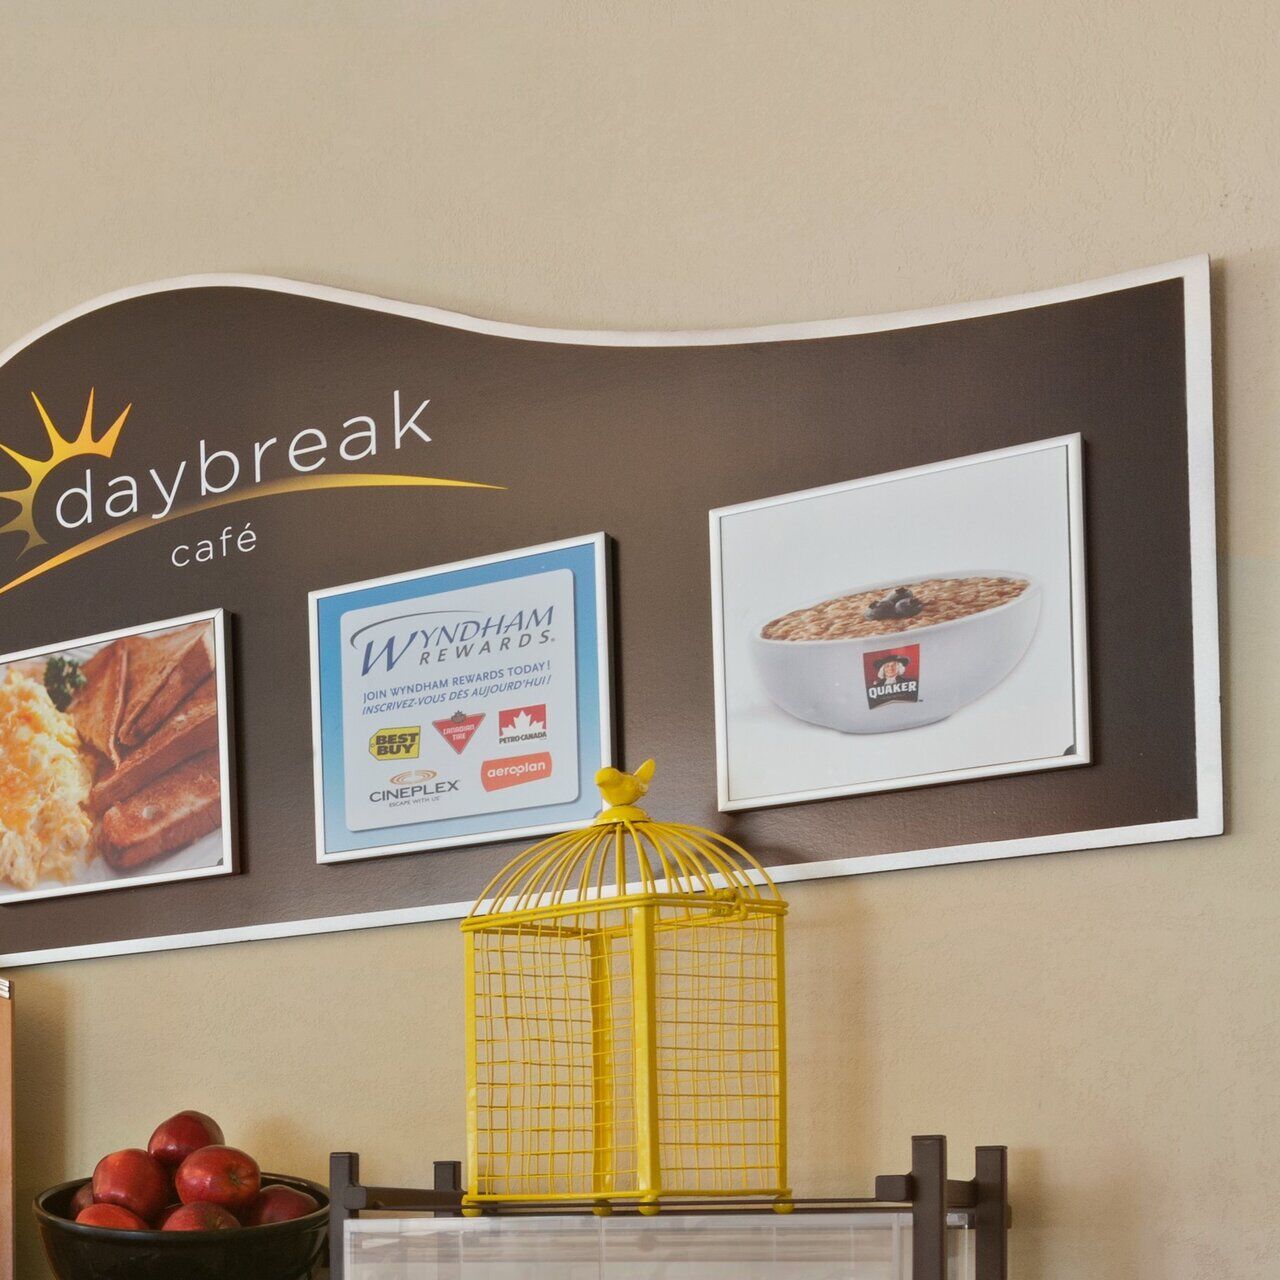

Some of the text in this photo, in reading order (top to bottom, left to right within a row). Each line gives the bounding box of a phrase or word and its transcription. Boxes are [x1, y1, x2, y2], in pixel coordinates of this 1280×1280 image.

[55, 389, 432, 529] daybreak
[171, 523, 257, 567] café
[361, 605, 555, 677] WYNDHAM
[363, 690, 388, 704] JOIN
[390, 678, 449, 697] WYNDHAM
[452, 668, 505, 687] REWARDS
[869, 681, 917, 699] QUAKER
[362, 692, 447, 716] INSCRIVEZ-VOUS
[376, 732, 420, 746] BEST
[377, 743, 415, 756] BUY
[487, 760, 547, 777] aeroplan
[369, 780, 460, 803] CINEPLEX
